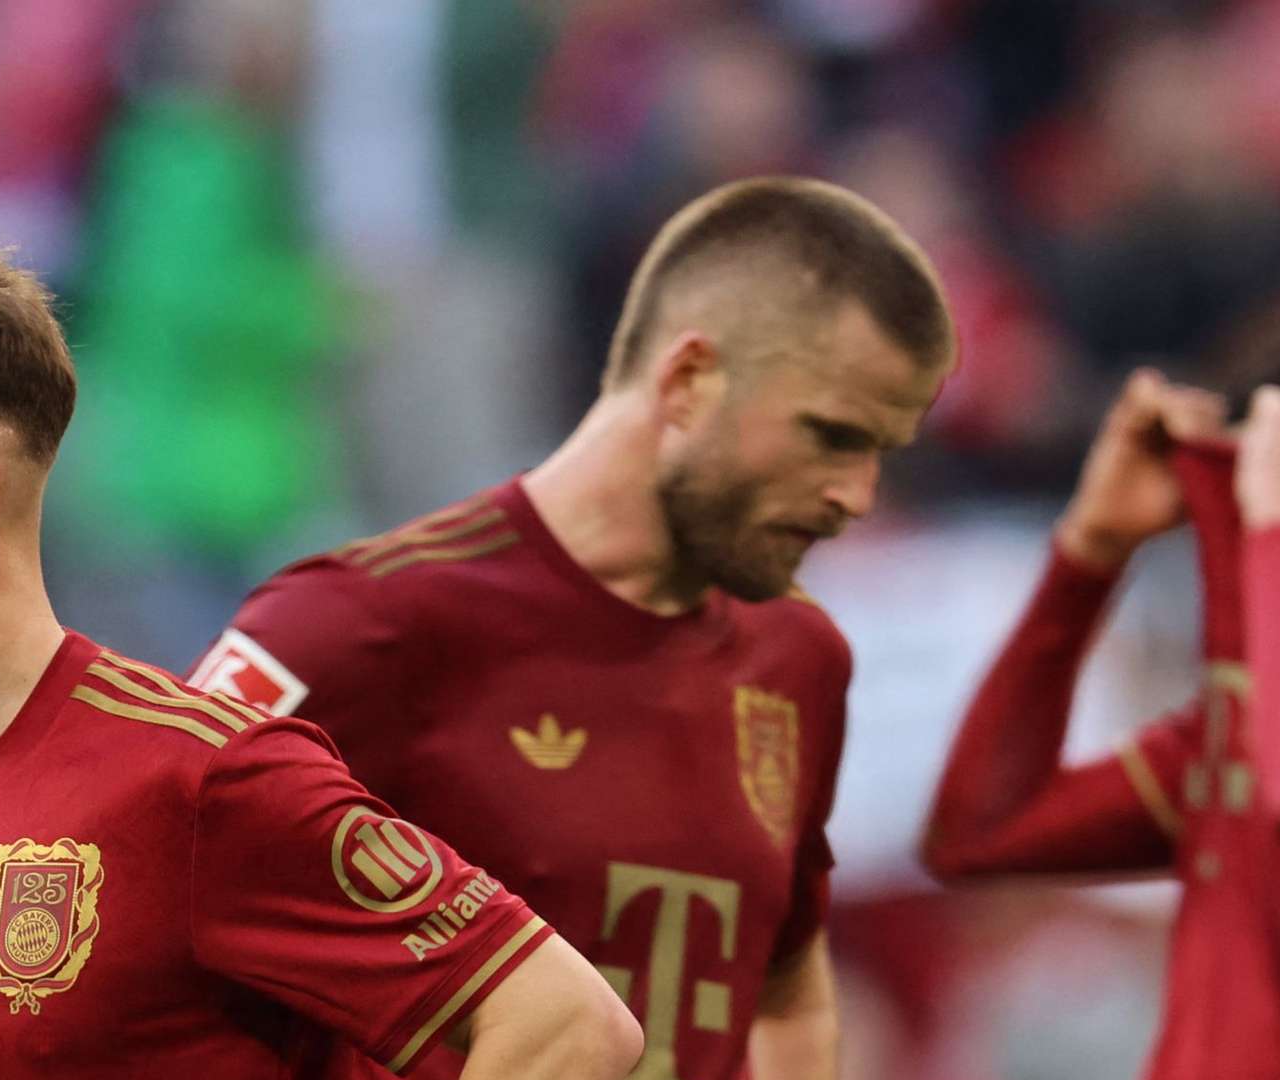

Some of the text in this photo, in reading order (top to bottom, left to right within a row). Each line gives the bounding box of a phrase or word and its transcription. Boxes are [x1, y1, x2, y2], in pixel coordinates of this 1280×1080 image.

[11, 872, 67, 905] 125
[22, 911, 55, 933] BAYERN
[401, 870, 500, 960] Allianz
